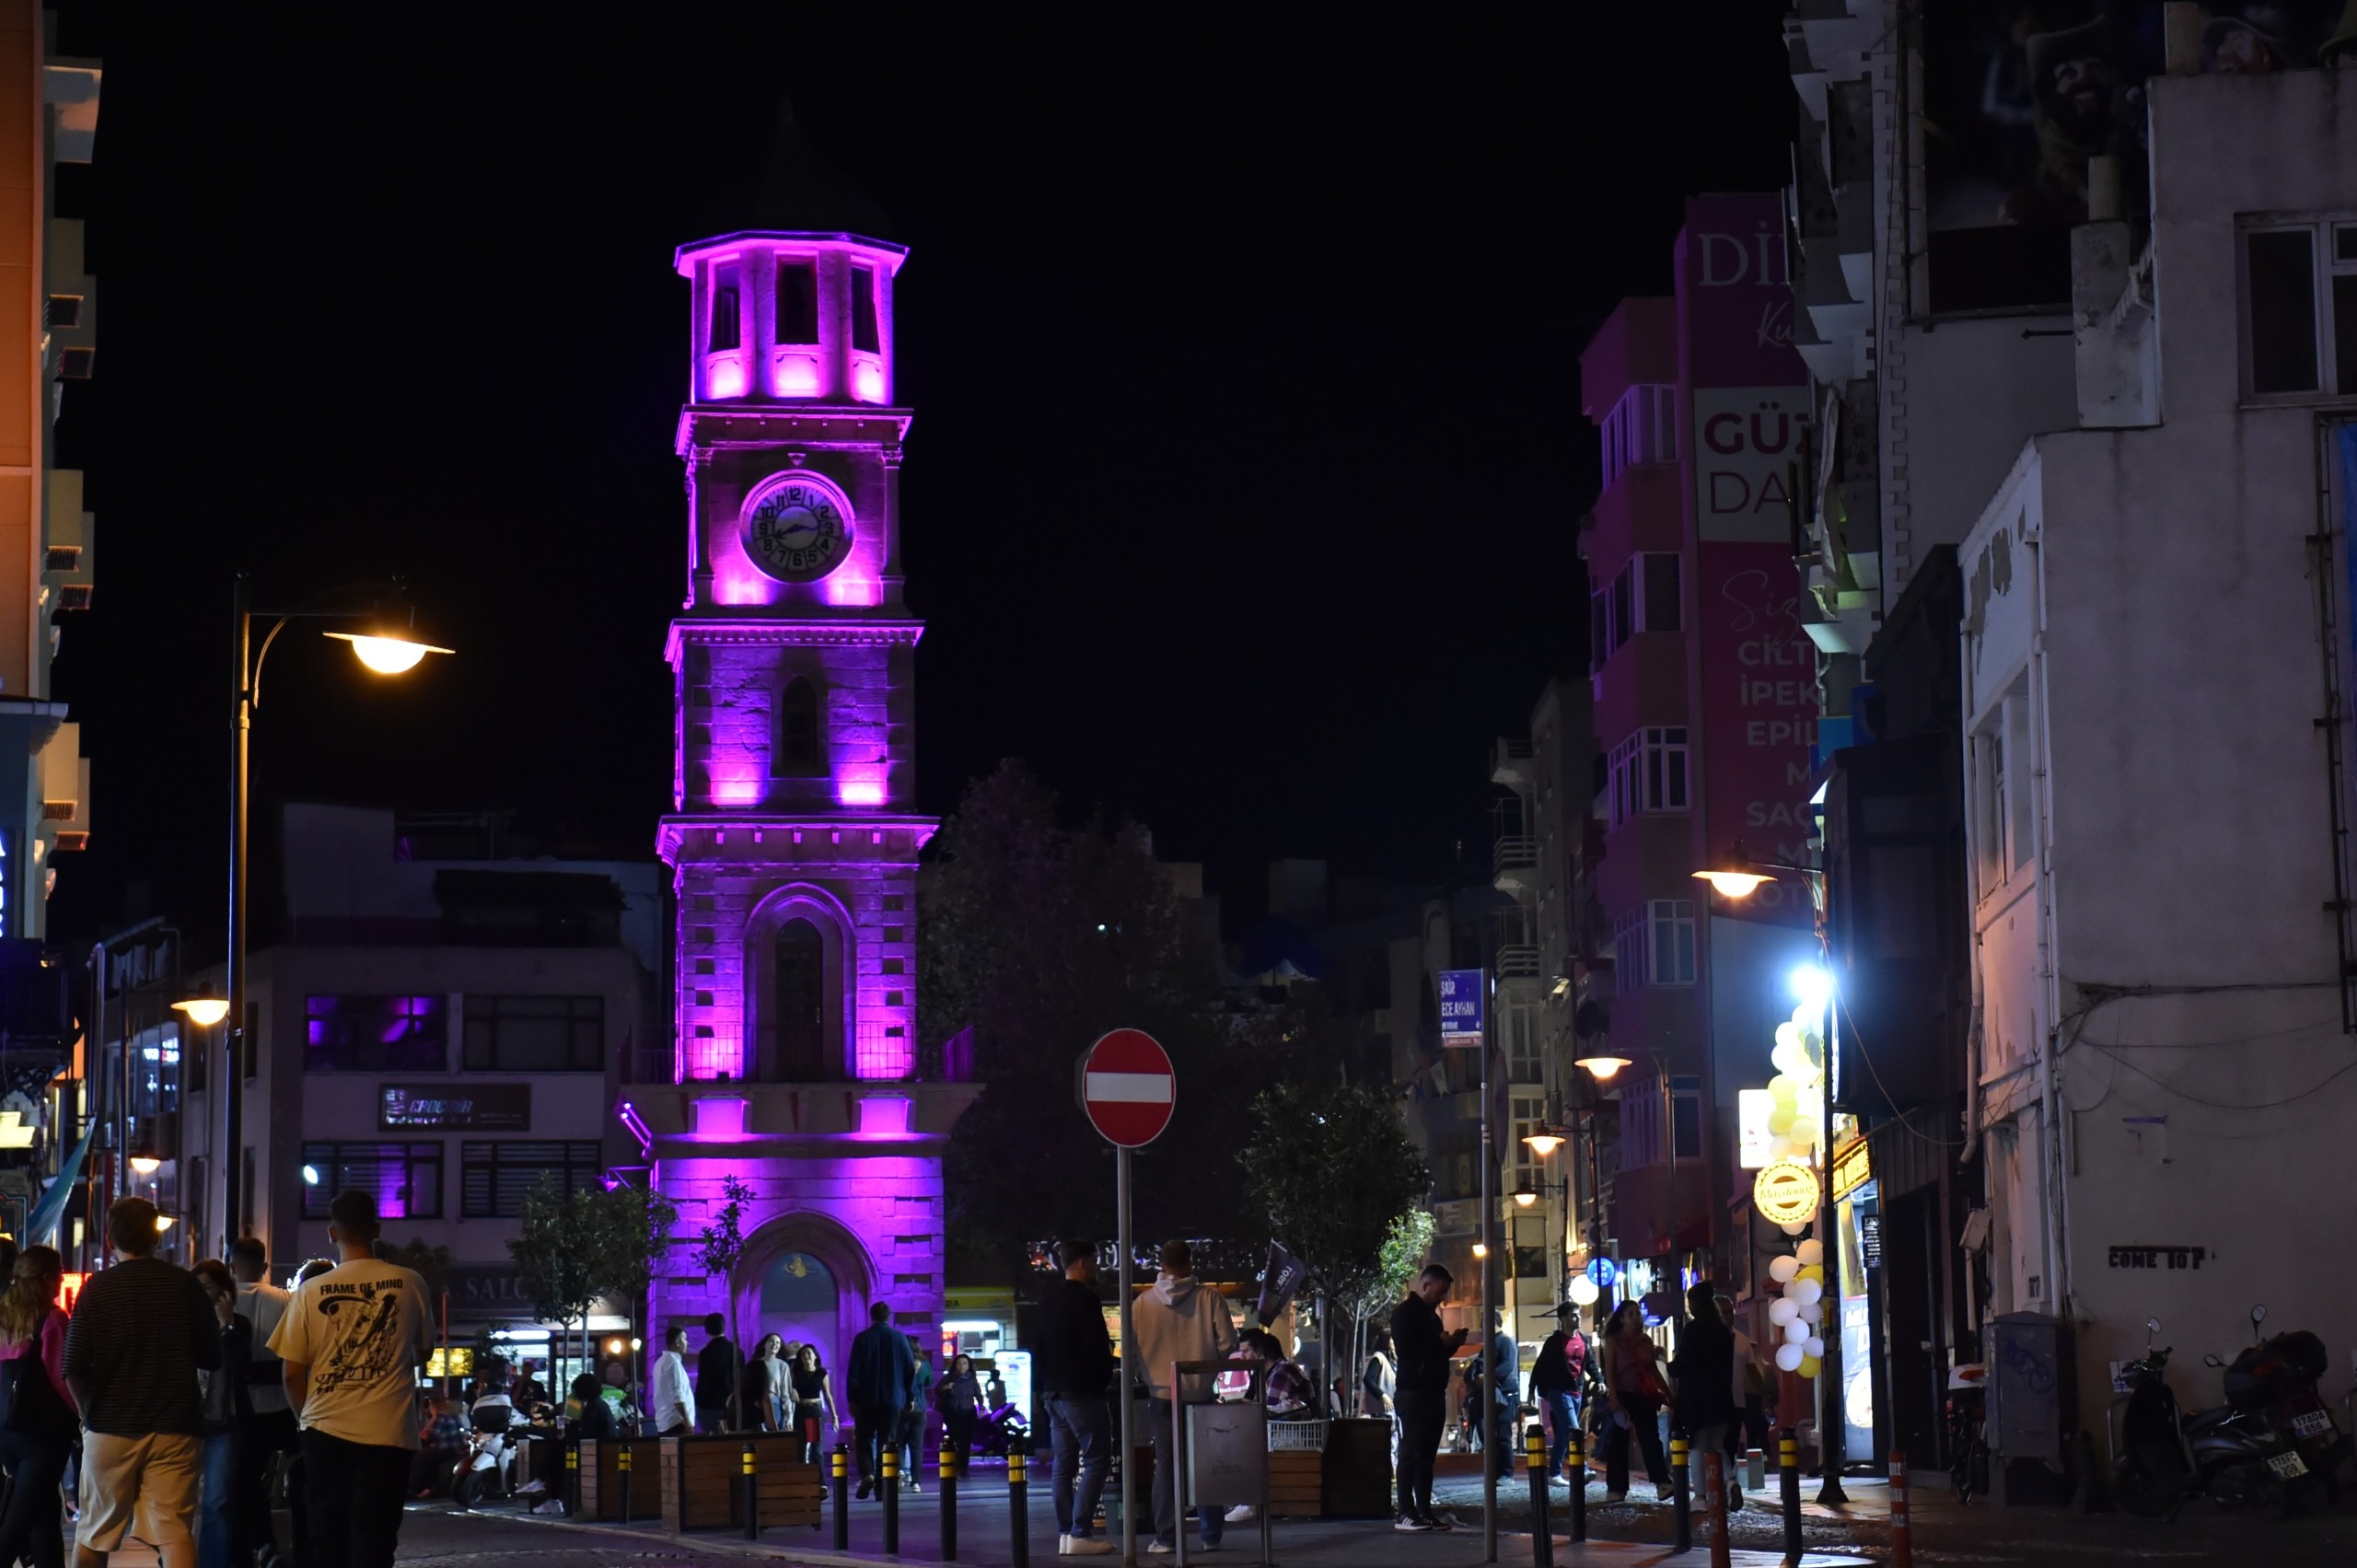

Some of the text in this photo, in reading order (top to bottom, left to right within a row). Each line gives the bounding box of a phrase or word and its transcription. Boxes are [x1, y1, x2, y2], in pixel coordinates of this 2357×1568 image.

[789, 487, 801, 501] 12
[808, 494, 814, 506] 1
[776, 495, 785, 507] 11
[761, 506, 774, 519] 10
[819, 505, 830, 518] 2
[759, 522, 768, 535] 9
[825, 522, 833, 534] 3
[764, 539, 772, 552] 8
[820, 539, 830, 552] 4
[778, 551, 786, 563] 7
[793, 553, 802, 566] 6
[807, 550, 817, 563] 5
[1737, 633, 1812, 667] CİLT
[1440, 978, 1457, 998] ŞAİR
[1441, 1001, 1475, 1016] ECE AYHAN
[320, 1279, 403, 1295] FRAME OF MIND
[2296, 1411, 2325, 1426] 17ADA
[2270, 1453, 2297, 1467] 17AFC
